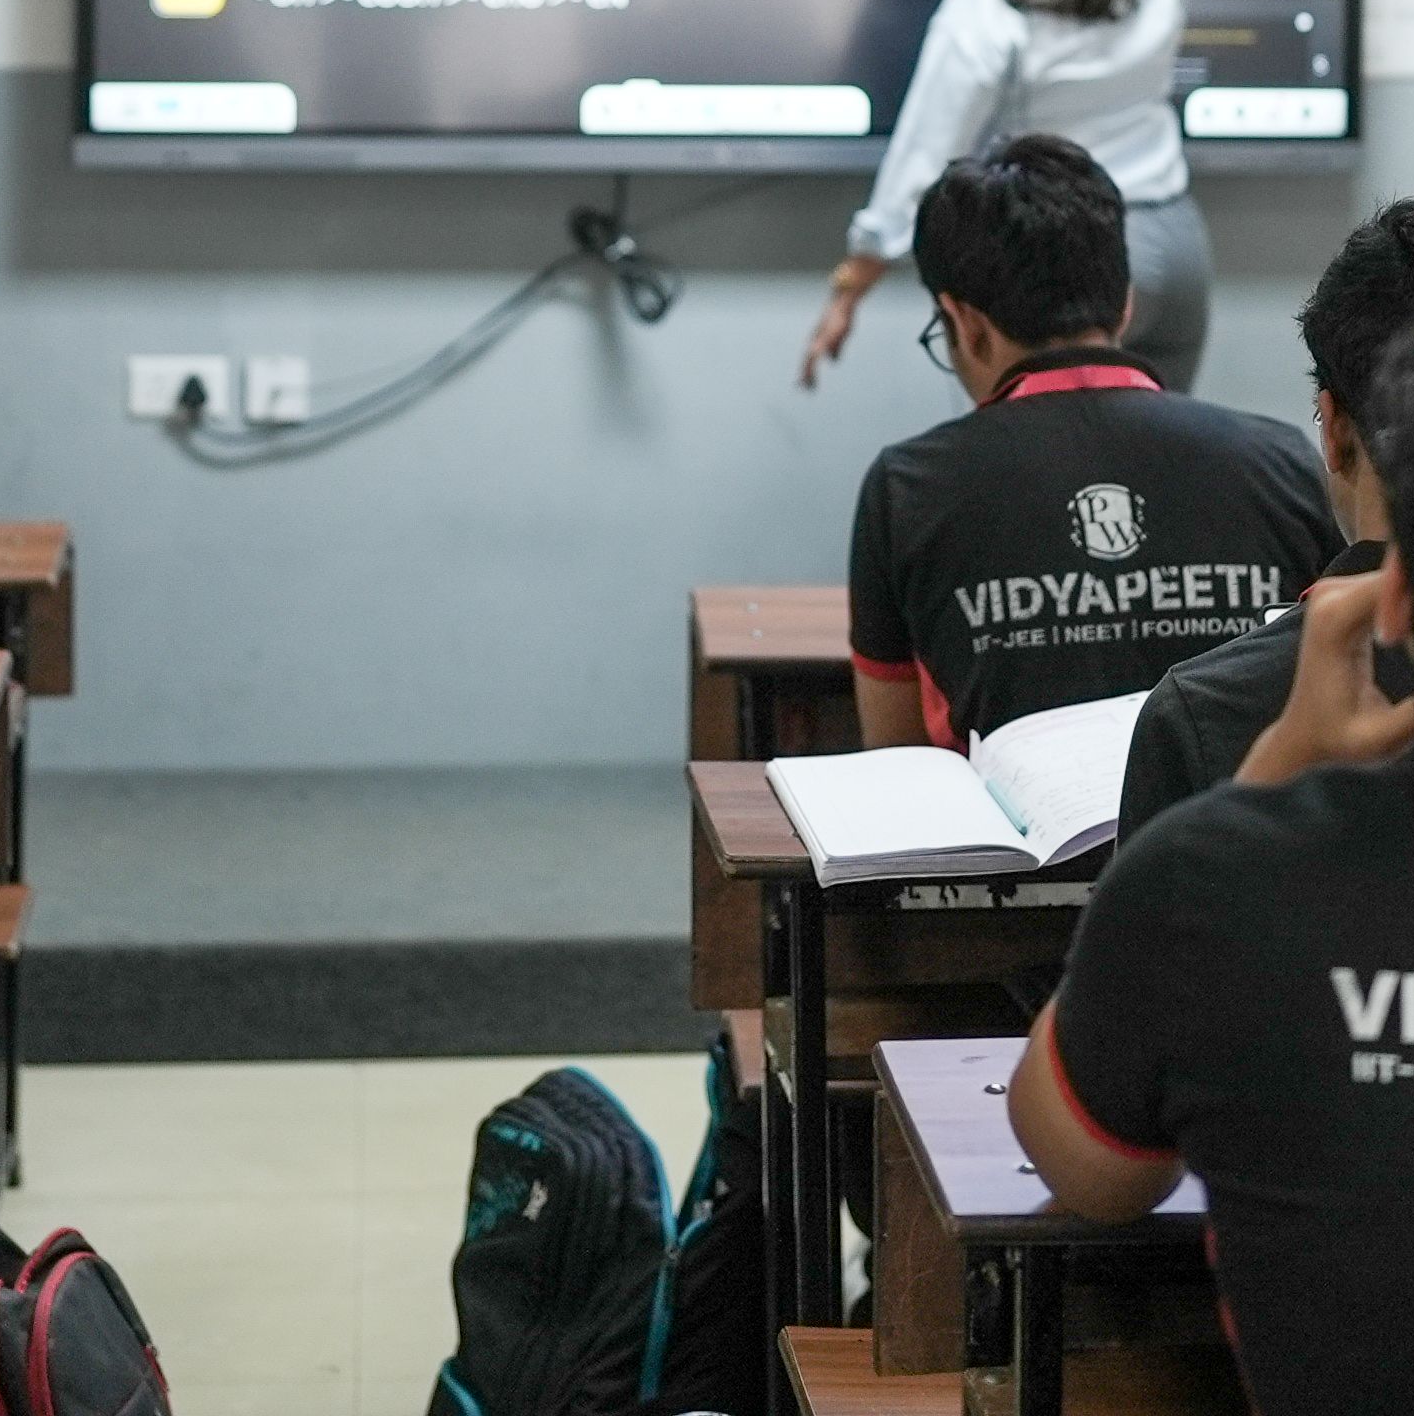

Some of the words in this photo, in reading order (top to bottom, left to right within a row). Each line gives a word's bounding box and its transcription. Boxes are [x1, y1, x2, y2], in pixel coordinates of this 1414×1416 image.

[954, 564, 1281, 629] VIDYAPEETH
[1064, 622, 1126, 644] NEET
[1142, 617, 1258, 640] FOUNDATI
